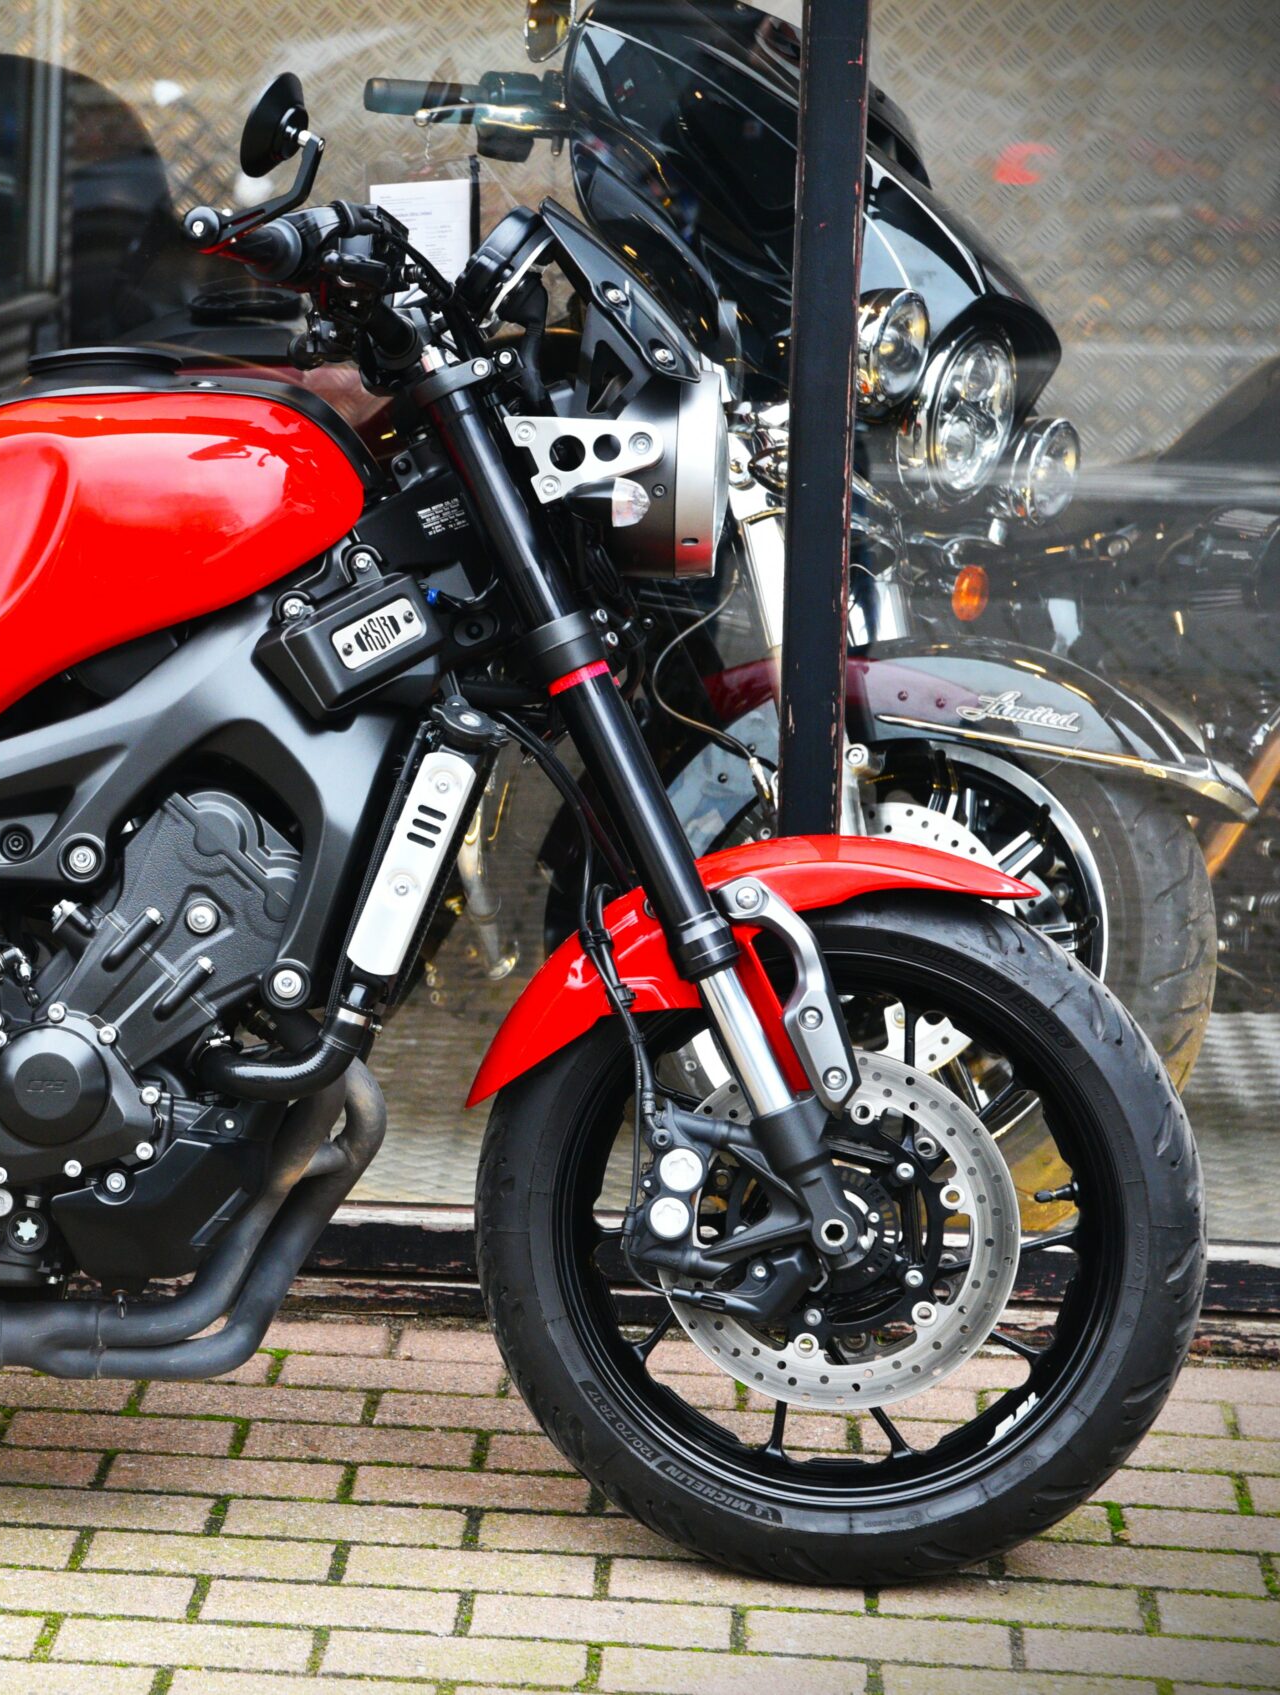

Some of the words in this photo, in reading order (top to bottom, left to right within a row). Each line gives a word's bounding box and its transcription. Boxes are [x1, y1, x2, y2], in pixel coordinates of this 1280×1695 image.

[360, 616, 395, 650] XSR
[956, 690, 1080, 732] Limited
[917, 943, 1007, 991] MICHELIN
[1022, 1001, 1058, 1034] ROAD
[587, 1389, 600, 1402] 17
[600, 1402, 617, 1421] ZR
[615, 1421, 653, 1459] 120/70
[665, 1465, 754, 1512] MICHELIN
